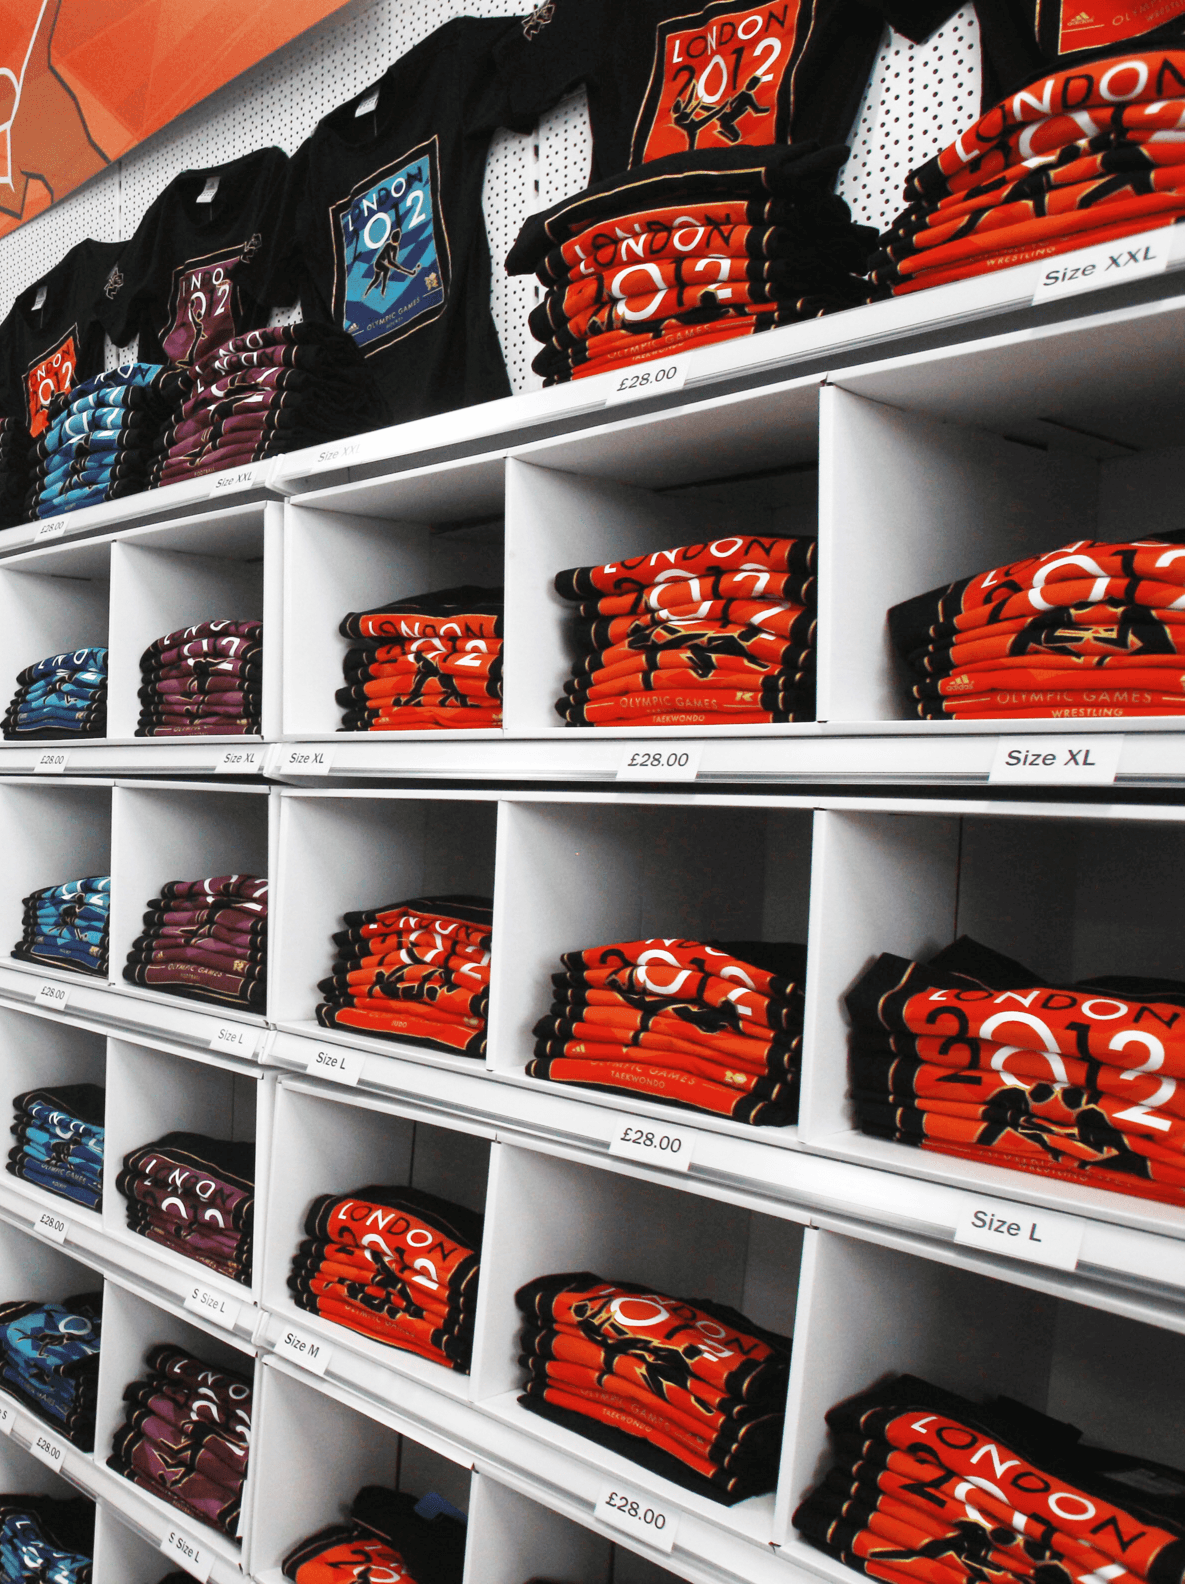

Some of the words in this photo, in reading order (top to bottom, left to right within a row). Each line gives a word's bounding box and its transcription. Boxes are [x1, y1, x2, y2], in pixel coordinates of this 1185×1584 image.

[672, 4, 788, 64] LONDON
[672, 37, 782, 108] 2012
[349, 165, 423, 231] LONDON
[348, 189, 426, 262] 2012
[574, 212, 736, 275] LONDON
[1043, 263, 1096, 286] Size
[1104, 246, 1157, 272] XXL
[366, 311, 397, 331] OLYMPIC
[397, 296, 421, 316] GAMES
[616, 366, 677, 392] £28.00
[317, 450, 339, 463] Size
[341, 444, 361, 458] XXL
[215, 477, 235, 489] Size
[235, 471, 253, 484] XXL
[40, 521, 65, 535] £28.00
[603, 537, 778, 574] LONDON
[619, 696, 671, 708] OLYMPIC
[675, 697, 718, 709] GAMES
[1084, 690, 1152, 704] GAMES
[652, 714, 705, 723] TAEKWONDO
[1051, 708, 1123, 719] WRESTLING
[40, 755, 65, 765] £28.00
[223, 752, 242, 764] Size
[243, 752, 256, 764] XL
[288, 752, 309, 765] Size
[311, 752, 324, 765] XL
[628, 752, 689, 768] £28.00
[1005, 750, 1057, 767] Size
[1064, 749, 1096, 766] XL
[168, 963, 195, 973] OLYMPIC
[198, 966, 223, 978] GAMES
[41, 986, 65, 1000] £28.00
[928, 989, 1181, 1030] LONDON
[391, 1019, 407, 1028] JUDO
[218, 1029, 237, 1043] Size
[238, 1033, 244, 1045] L
[316, 1052, 338, 1067] Size
[339, 1057, 346, 1070] L
[611, 1070, 665, 1089] TAEKWONDO
[649, 1067, 696, 1086] GAMES
[620, 1126, 682, 1153] £28.00
[65, 1166, 87, 1185] GAMES
[39, 1214, 65, 1232] £28.00
[338, 1202, 458, 1262] LONDON
[971, 1210, 1021, 1238] Size
[1028, 1223, 1042, 1243] L
[191, 1288, 199, 1299] S
[200, 1291, 219, 1310] Size
[219, 1301, 226, 1314] L
[284, 1332, 307, 1352] Size
[307, 1344, 320, 1359] M
[2, 1410, 8, 1420] S
[602, 1408, 653, 1433] TAEKWONDO
[36, 1437, 61, 1460] £28.00
[911, 1416, 1147, 1553] LONDON
[605, 1492, 666, 1530] £28.00
[168, 1531, 176, 1544] S
[176, 1537, 194, 1558] Size
[194, 1551, 201, 1563] L
